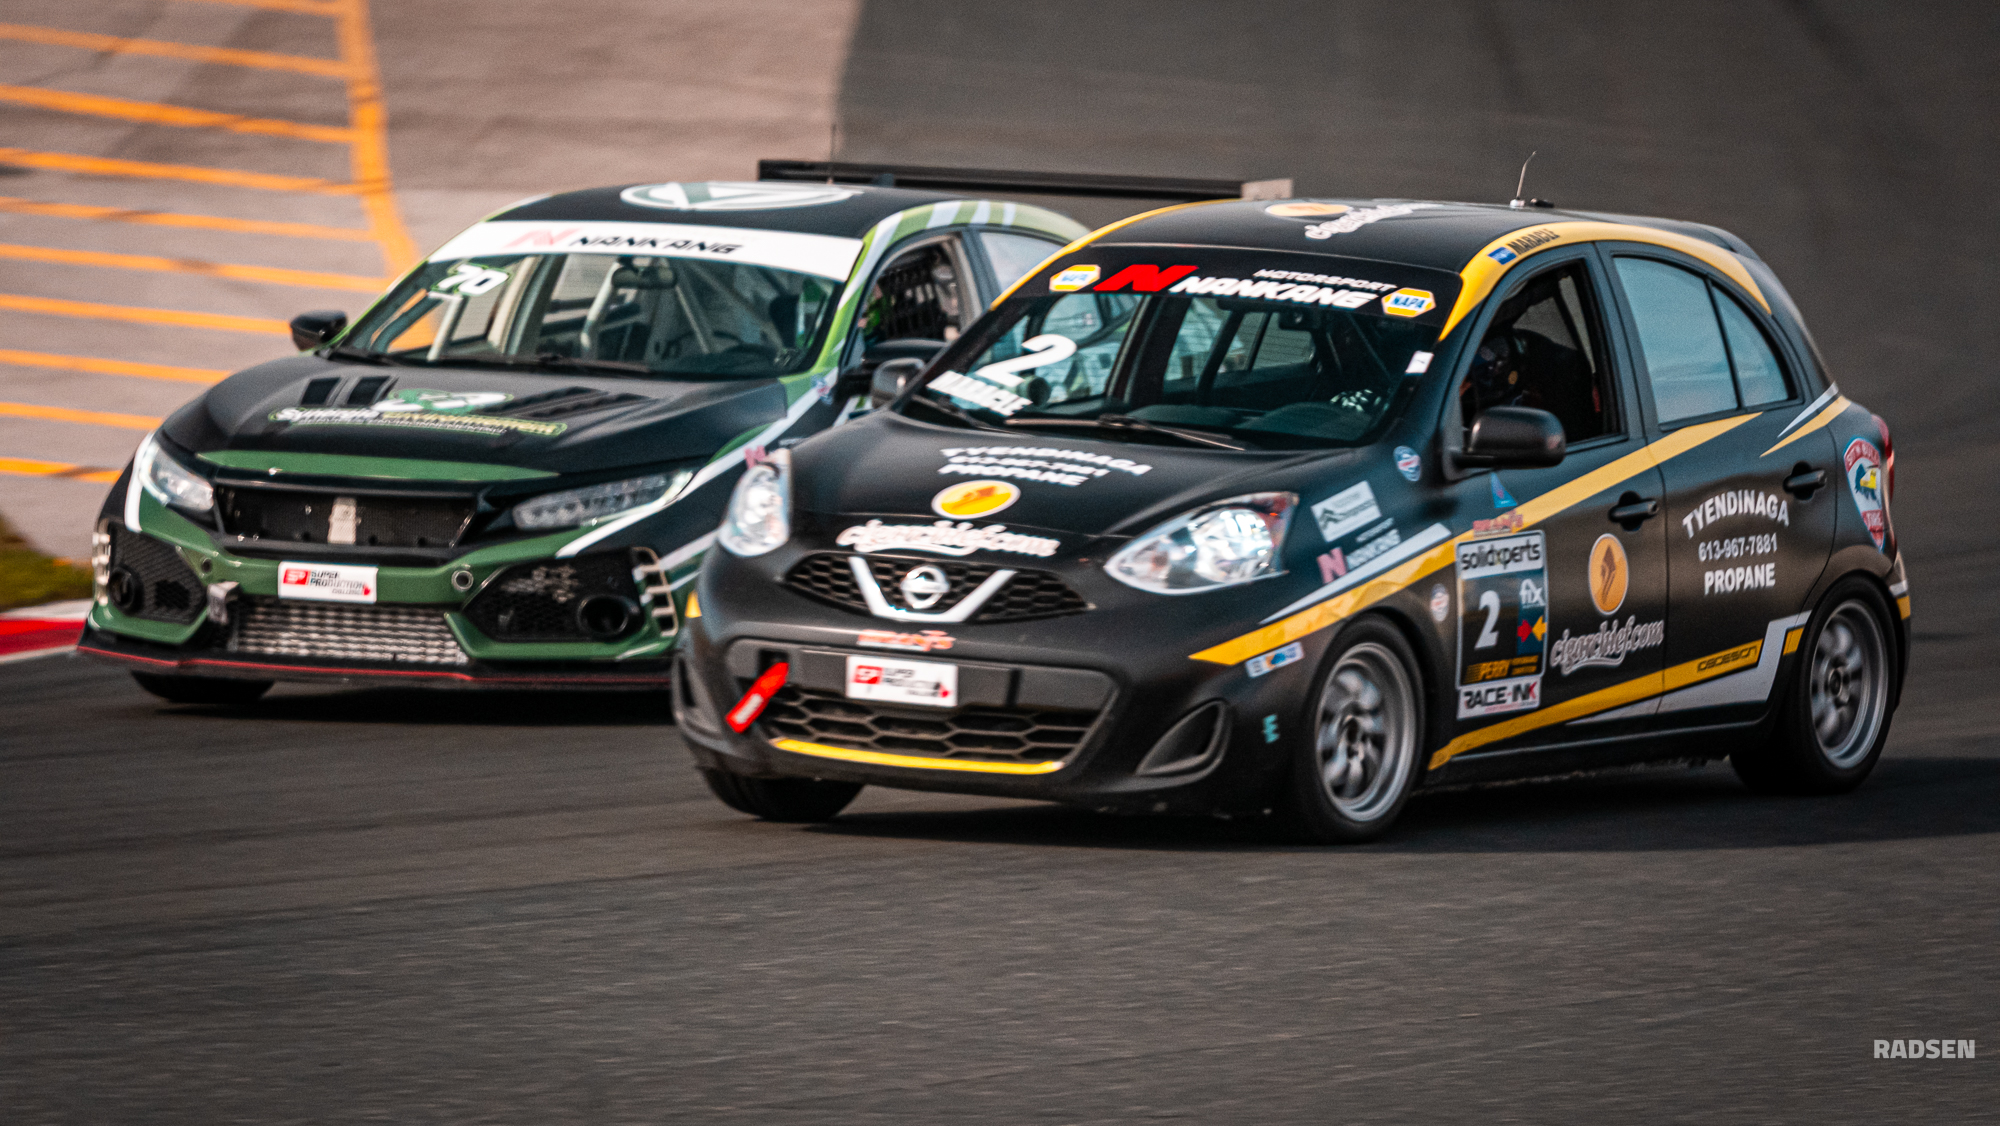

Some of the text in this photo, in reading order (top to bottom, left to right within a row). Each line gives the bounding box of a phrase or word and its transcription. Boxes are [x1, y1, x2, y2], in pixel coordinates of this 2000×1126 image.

[569, 236, 744, 254] NANKANG
[436, 262, 509, 296] 70
[1168, 275, 1379, 310] NANKANG
[1252, 268, 1398, 292] MOTORSPORT
[1391, 294, 1426, 309] NAPA
[975, 333, 1077, 388] 2
[937, 463, 1090, 486] PROPANE
[940, 446, 1153, 477] TYENDINAGA
[1682, 489, 1790, 539] TYENDINAGA
[1698, 532, 1778, 562] 613-967-7881
[1704, 562, 1776, 596] PROPANE
[1474, 590, 1501, 650] 2
[1550, 615, 1665, 677] cigarchief.com
